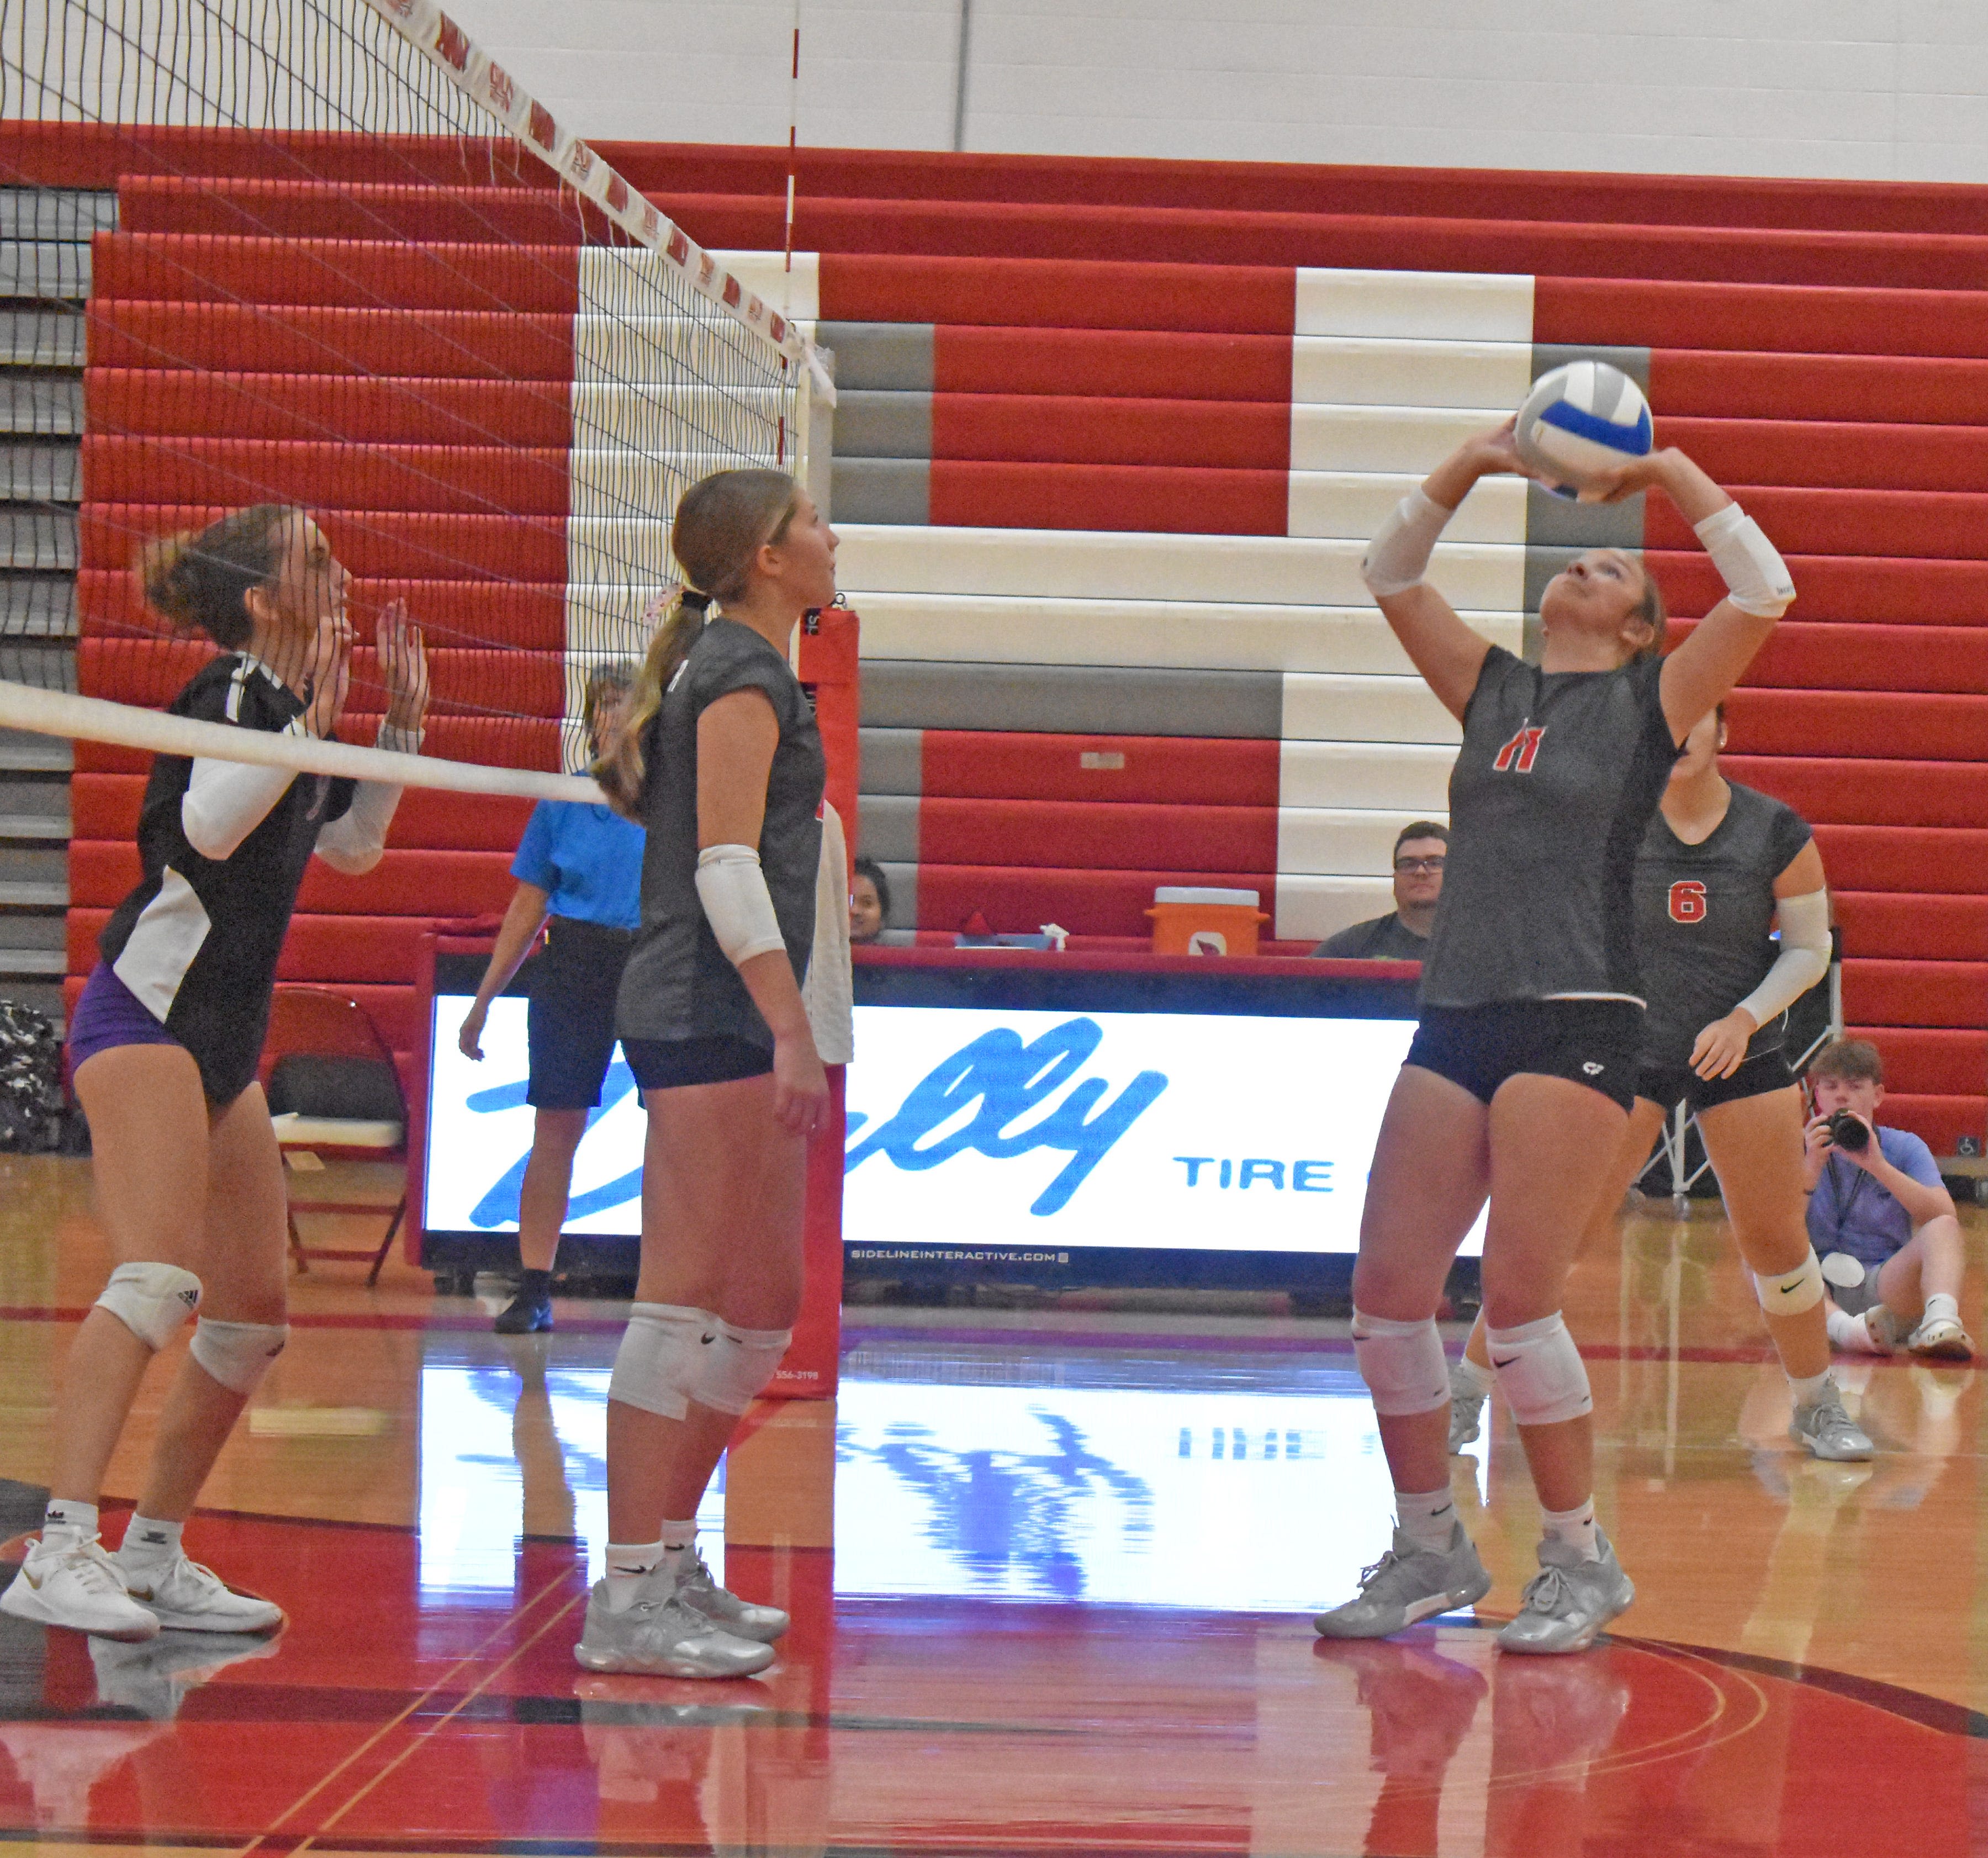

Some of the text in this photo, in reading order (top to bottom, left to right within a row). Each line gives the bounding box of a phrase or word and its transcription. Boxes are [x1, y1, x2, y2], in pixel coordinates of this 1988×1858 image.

[1493, 717, 1548, 773] 11
[1668, 880, 1707, 923] 6
[1172, 1157, 1334, 1192] TIRE
[851, 1249, 1056, 1262] SIDELINEINTERACTIVE.COM
